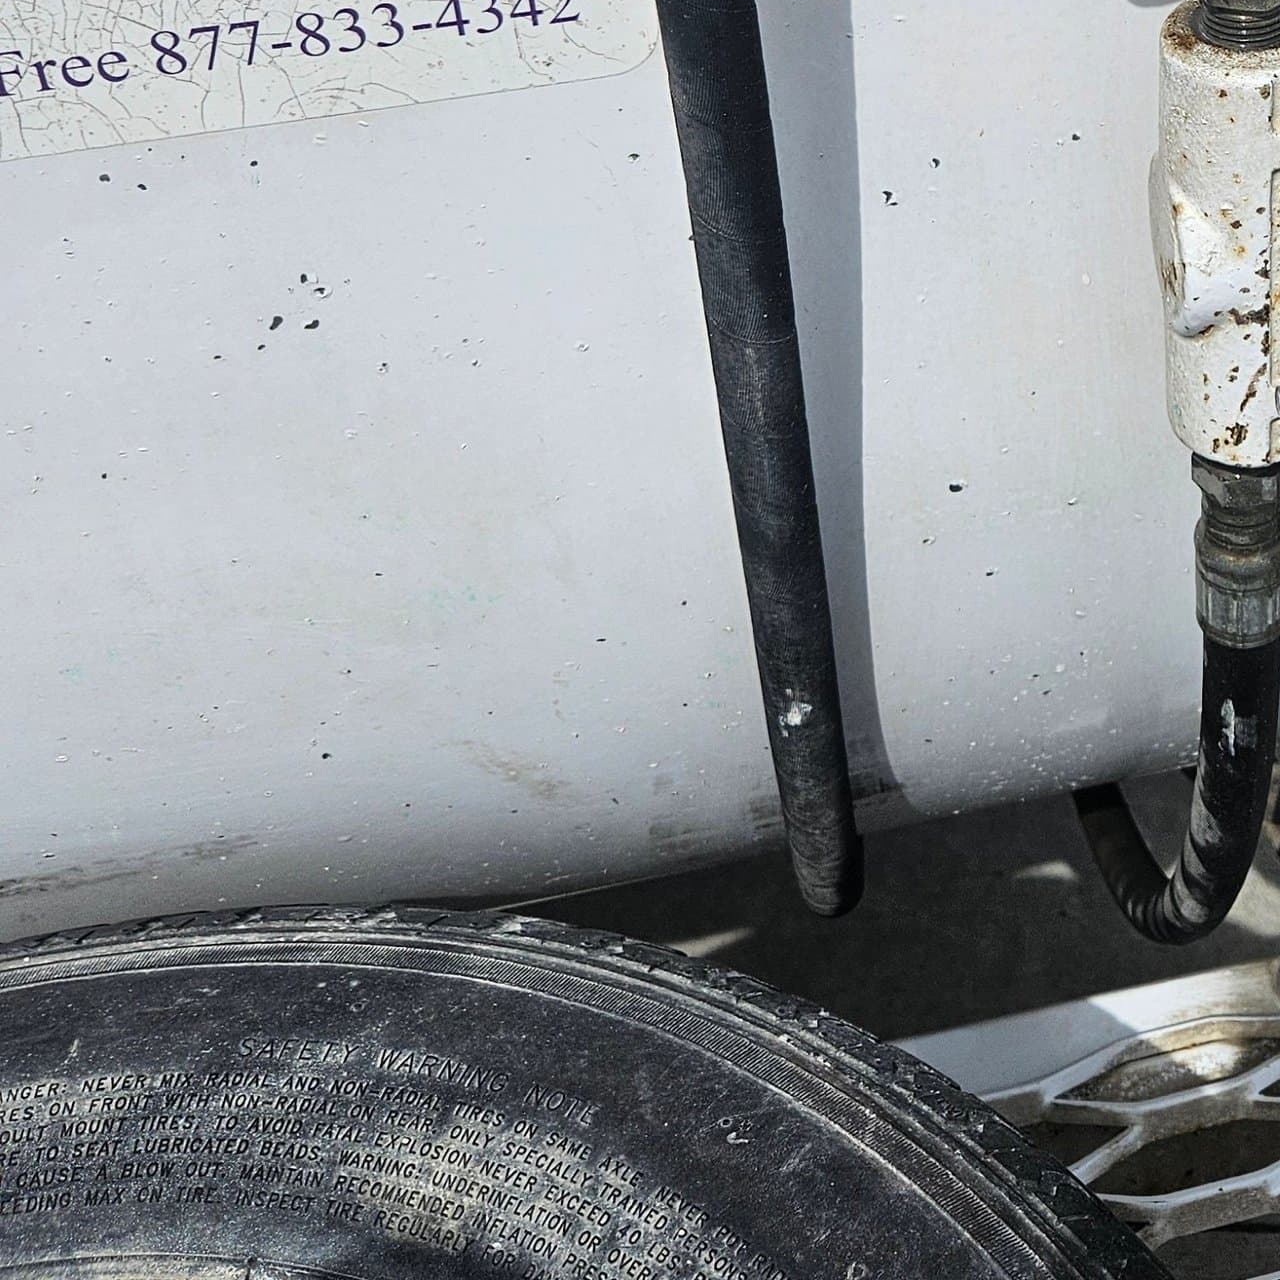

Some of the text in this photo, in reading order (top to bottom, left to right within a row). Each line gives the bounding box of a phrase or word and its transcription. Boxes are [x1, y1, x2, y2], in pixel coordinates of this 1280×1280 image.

[0, 51, 130, 97] Free
[239, 1037, 600, 1126] SAFETY WARNING NOTE
[0, 1083, 67, 1104] NGER:
[81, 1074, 147, 1093] NEVER
[159, 1073, 194, 1088] MIX
[206, 1071, 272, 1088] RADIAL
[282, 1075, 320, 1091] AND
[330, 1079, 441, 1112] NON-RADIAL
[453, 1101, 505, 1127] TIRES
[514, 1120, 538, 1139] ON
[546, 1132, 593, 1161] SAME
[598, 1156, 644, 1188] AXLE
[655, 1185, 710, 1227] NEVER
[715, 1224, 750, 1256] PUT
[16, 1167, 85, 1189] CAUSE
[95, 1163, 108, 1181] A
[121, 1162, 176, 1179] BLOW
[239, 1164, 325, 1188] MAINTAIN
[333, 1174, 465, 1222] RECOMMENDED
[472, 1211, 558, 1259] INFLATION
[36, 1146, 59, 1163] TO
[73, 1139, 122, 1159] SEAT
[134, 1137, 249, 1155] LUBRICATED
[432, 1171, 572, 1237] UNDERINFLATION
[578, 1230, 601, 1253] OR
[49, 1101, 76, 1116] ON
[88, 1094, 153, 1114] FRONT
[164, 1093, 209, 1109] WITH
[222, 1093, 337, 1116] NON-RADIAL
[350, 1104, 375, 1120] ON
[385, 1109, 437, 1134] REAR.
[450, 1125, 496, 1150] ONLY
[502, 1141, 593, 1188] SPECIALLY
[599, 1182, 668, 1230] TRAINED
[673, 1227, 748, 1280] PERSONS
[60, 1118, 127, 1138] MOUNT
[215, 1115, 238, 1131] TO
[248, 1117, 302, 1135] AVOID
[312, 1122, 363, 1144] FATAL
[374, 1131, 472, 1169] EXPLOSION
[480, 1160, 538, 1193] NEVER
[544, 1184, 611, 1227] EXCEED
[617, 1224, 642, 1245] 40
[85, 1187, 126, 1207] MAX
[137, 1187, 163, 1203] ON
[235, 1188, 316, 1214] INSPECT
[326, 1199, 364, 1221] TIRE
[373, 1209, 475, 1255] REGULARLY
[482, 1244, 516, 1270] FOR
